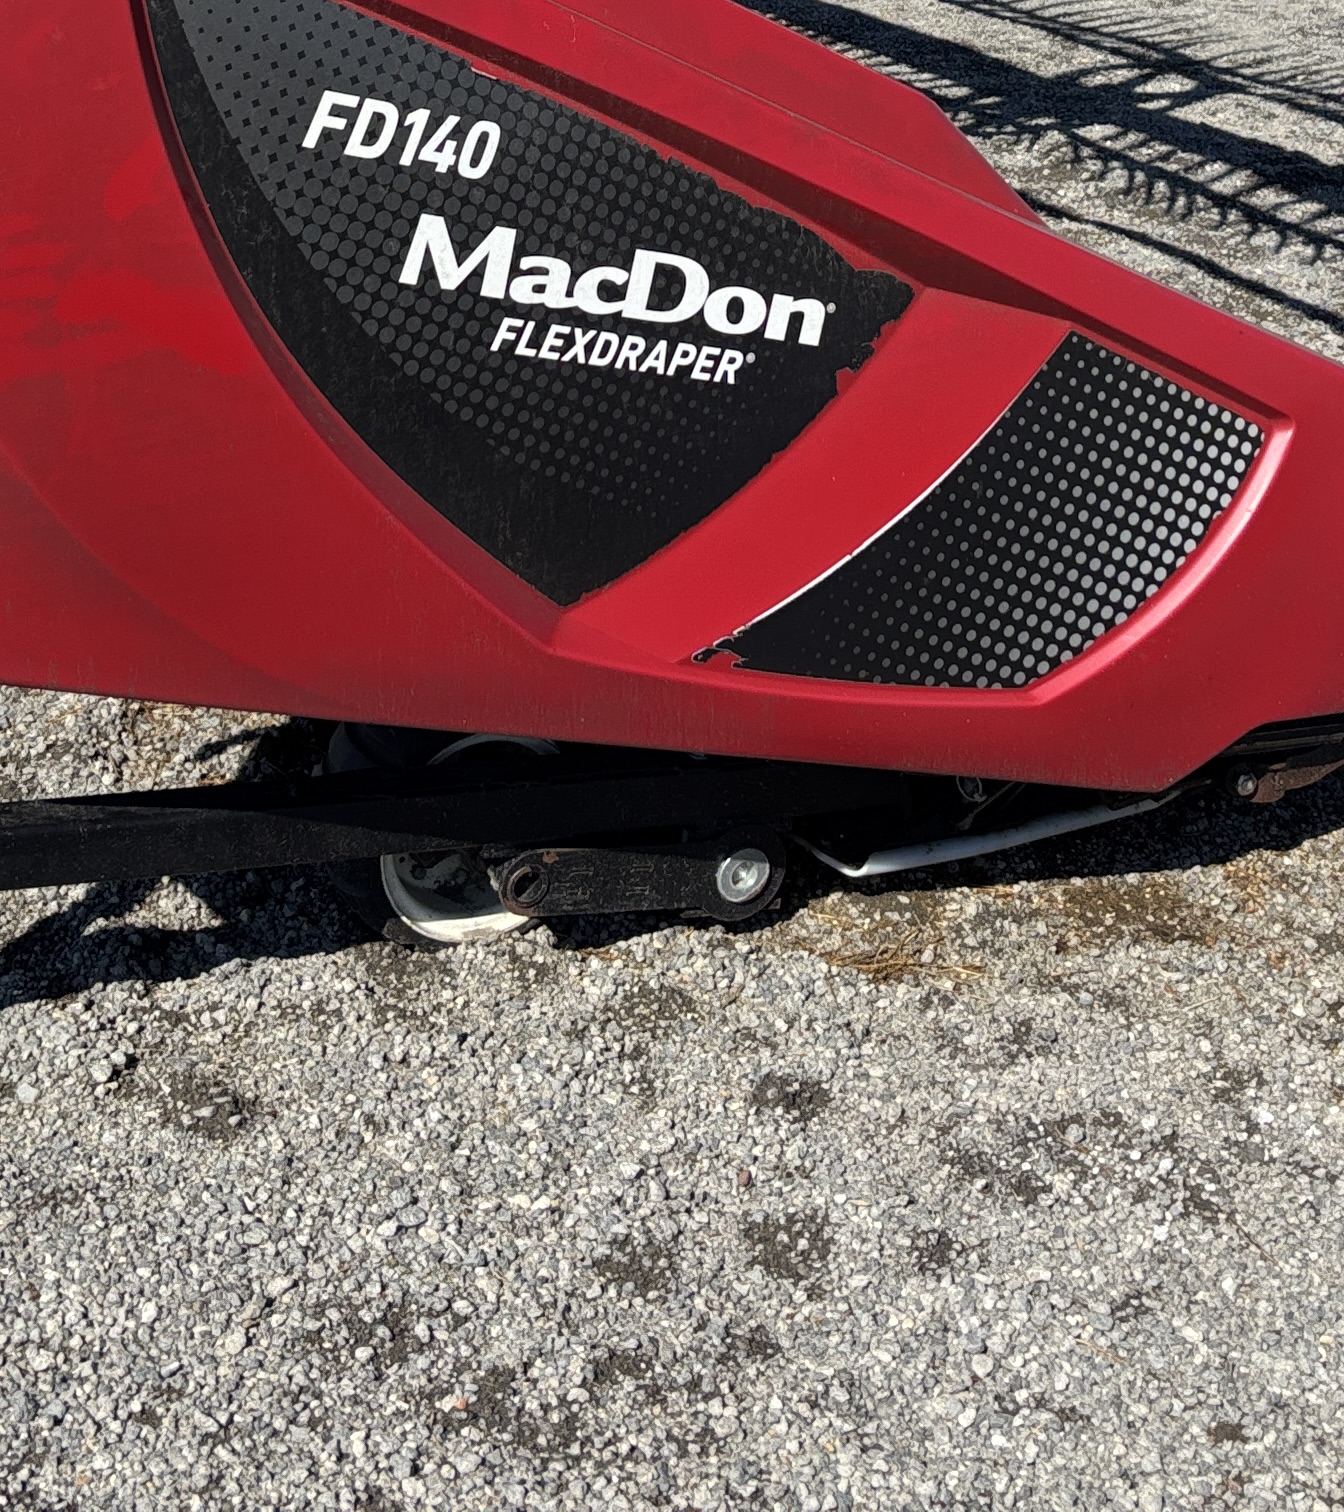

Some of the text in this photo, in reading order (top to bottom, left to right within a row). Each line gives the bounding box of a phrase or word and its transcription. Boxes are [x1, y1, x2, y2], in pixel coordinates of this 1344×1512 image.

[301, 89, 502, 180] FD140
[397, 212, 827, 347] MacDon
[489, 316, 745, 385] FLEXDRAPER
